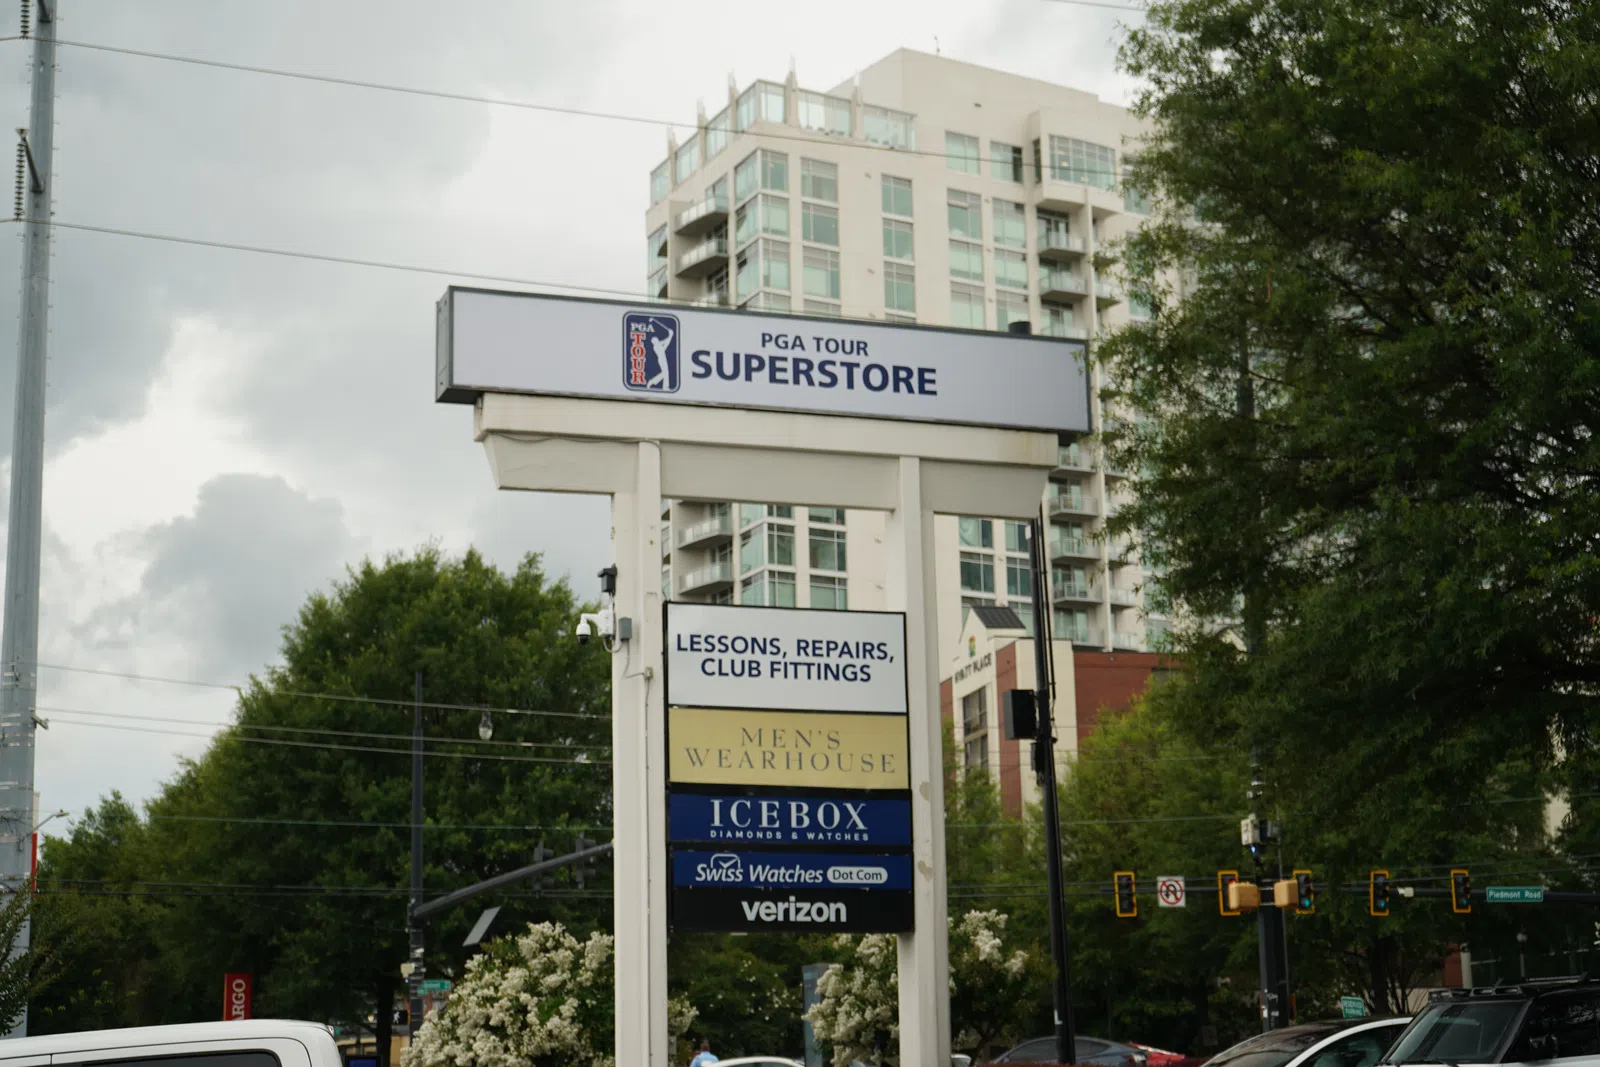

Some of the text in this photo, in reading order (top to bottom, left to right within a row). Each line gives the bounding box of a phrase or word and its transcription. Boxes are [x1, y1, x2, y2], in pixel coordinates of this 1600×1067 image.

[630, 322, 655, 333] PGA
[761, 332, 868, 357] PGA TOUR
[631, 332, 647, 385] TOUR
[691, 350, 937, 396] SUPERSTORE
[676, 633, 894, 664] LESSONS, REPAIRS,
[701, 658, 872, 682] CLUB FITTINGS
[740, 727, 841, 750] MEN'S
[685, 747, 896, 774] WEARHOUSE
[710, 799, 868, 830] ICEBOX
[710, 829, 869, 841] DIAMONDS & WATCHES
[695, 862, 882, 883] Swiss Watches Dot Com
[1489, 889, 1541, 899] Piedmont Road
[741, 896, 847, 922] verizon
